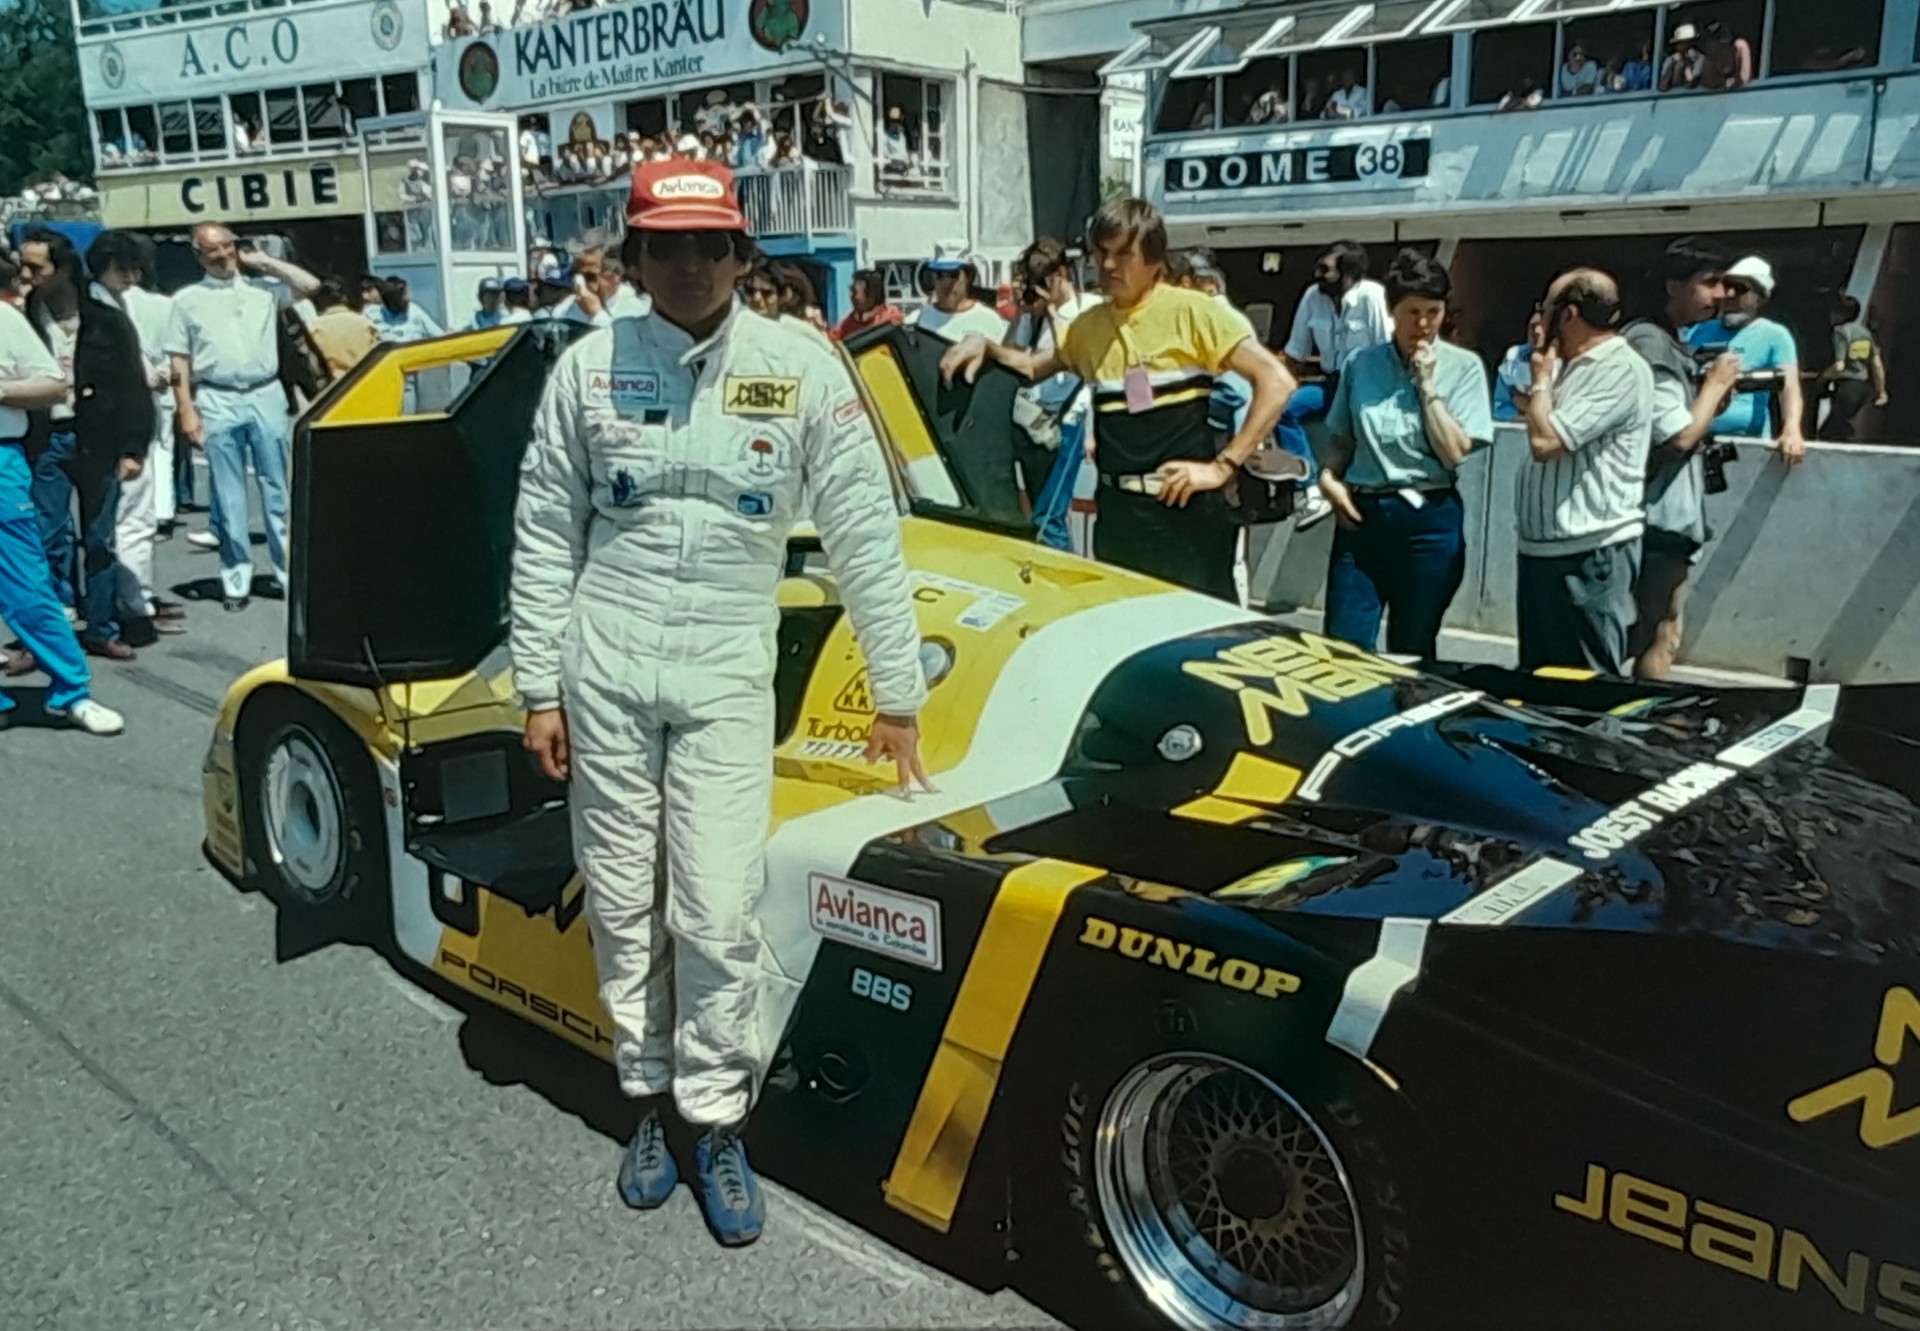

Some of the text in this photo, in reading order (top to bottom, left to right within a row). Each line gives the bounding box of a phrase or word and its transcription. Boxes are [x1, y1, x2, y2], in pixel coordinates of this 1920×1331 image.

[515, 0, 725, 76] KANTERBRÄU
[530, 80, 547, 99] La
[550, 75, 583, 95] bière
[583, 70, 599, 89] de
[654, 54, 704, 80] Kanter
[1181, 144, 1400, 188] DOME 38
[1567, 800, 1664, 859] JOEST
[816, 882, 927, 943] Avianca
[1079, 917, 1301, 999] DUNLOP
[440, 948, 614, 1046] PORSCH
[851, 967, 914, 1012] BBS
